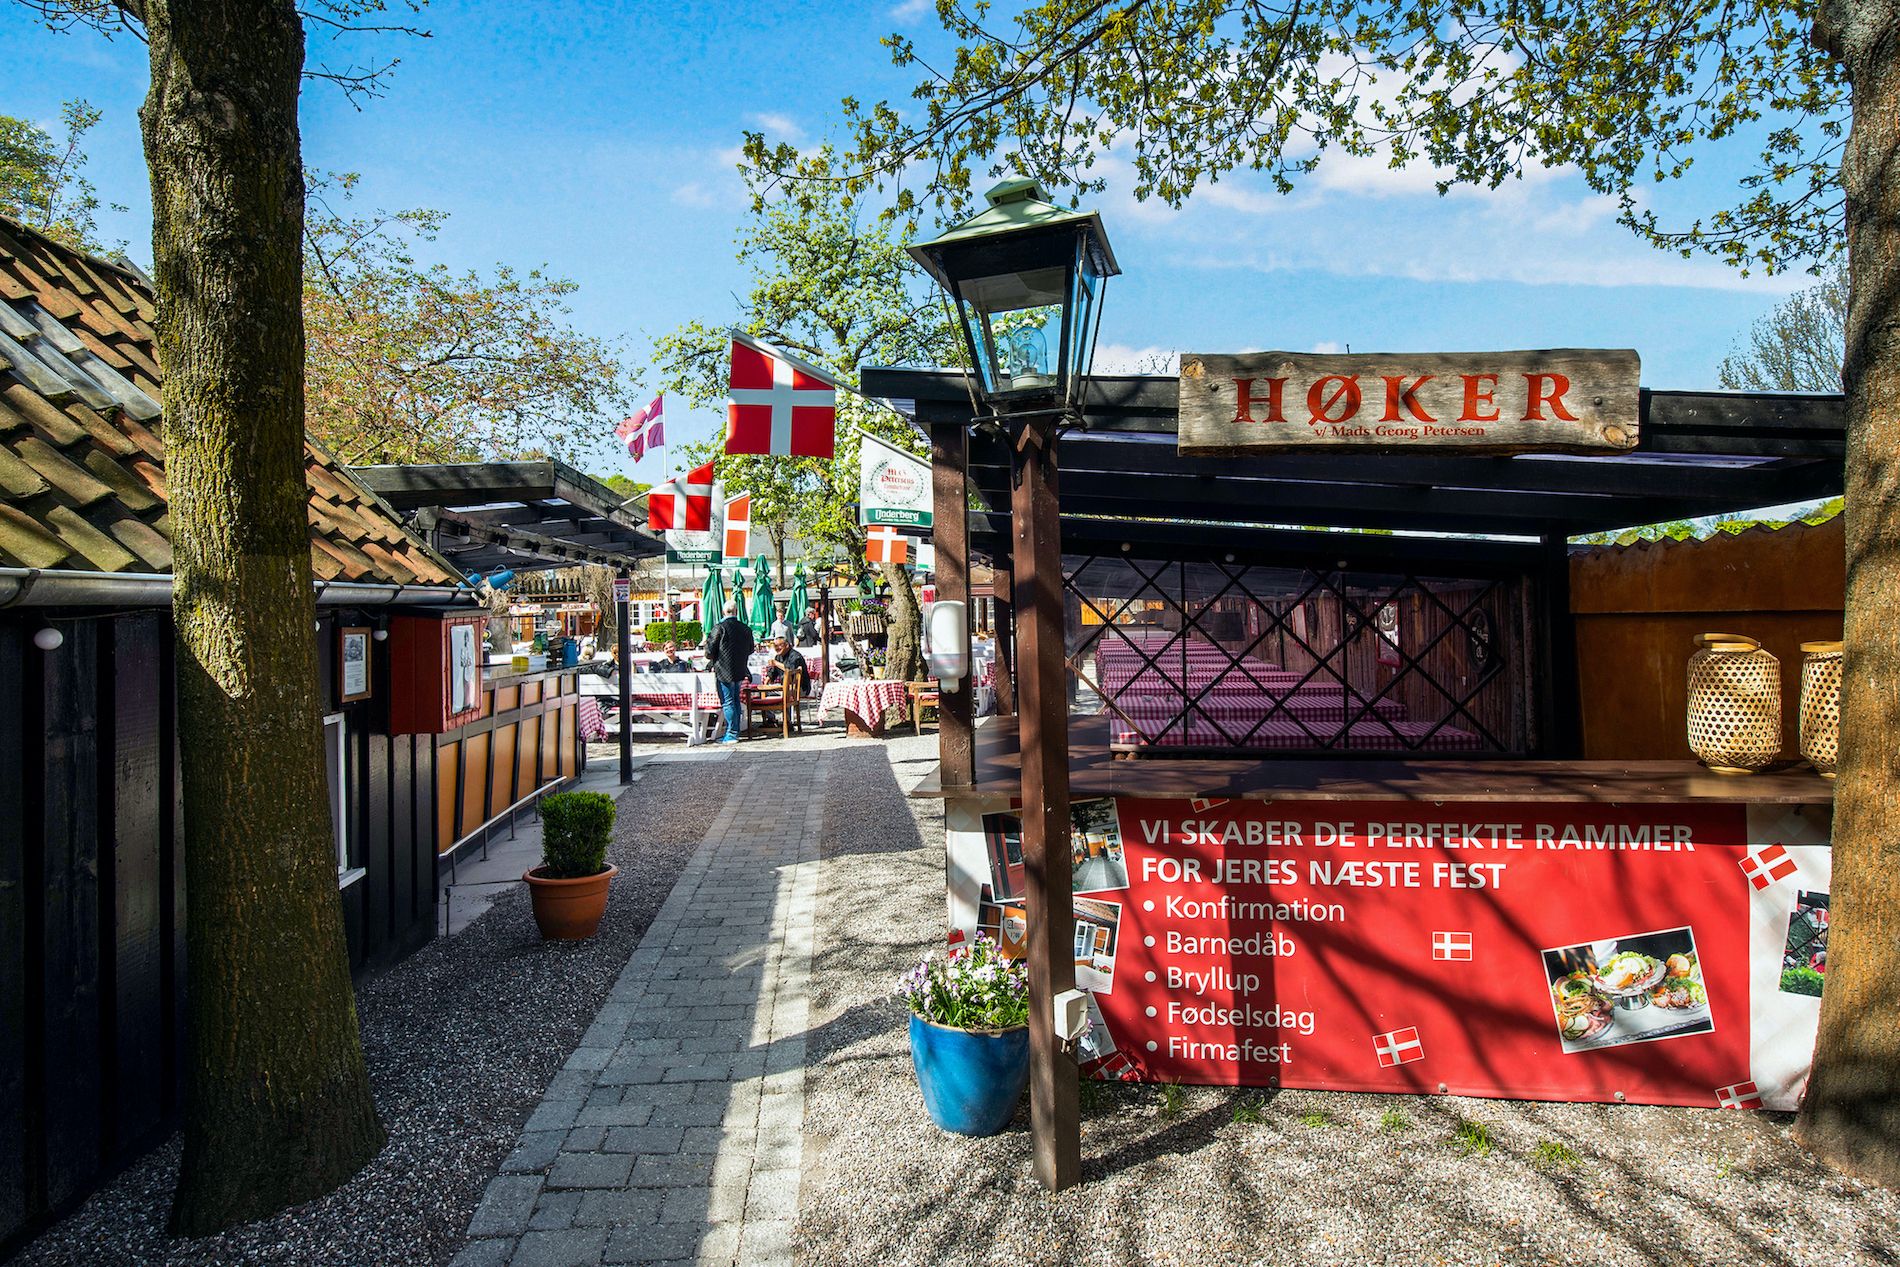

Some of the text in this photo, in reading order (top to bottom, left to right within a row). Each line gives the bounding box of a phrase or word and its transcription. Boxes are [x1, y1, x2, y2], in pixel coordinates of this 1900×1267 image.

[1230, 372, 1580, 426] HØKER
[1331, 425, 1371, 437] Mads
[1375, 425, 1419, 440] Georg
[1422, 424, 1486, 437] Petersen
[1139, 819, 1695, 852] VI SKABER DE PERFEKTE RAMMER
[1142, 857, 1507, 889] FOR JERES NÆSTE FEST
[1165, 895, 1345, 922] Konfirmation
[1166, 931, 1296, 957] Barnedåb
[1167, 966, 1260, 997] Bryllup
[1167, 1001, 1315, 1035] Fødselsdag
[1168, 1035, 1293, 1064] Firmafest
